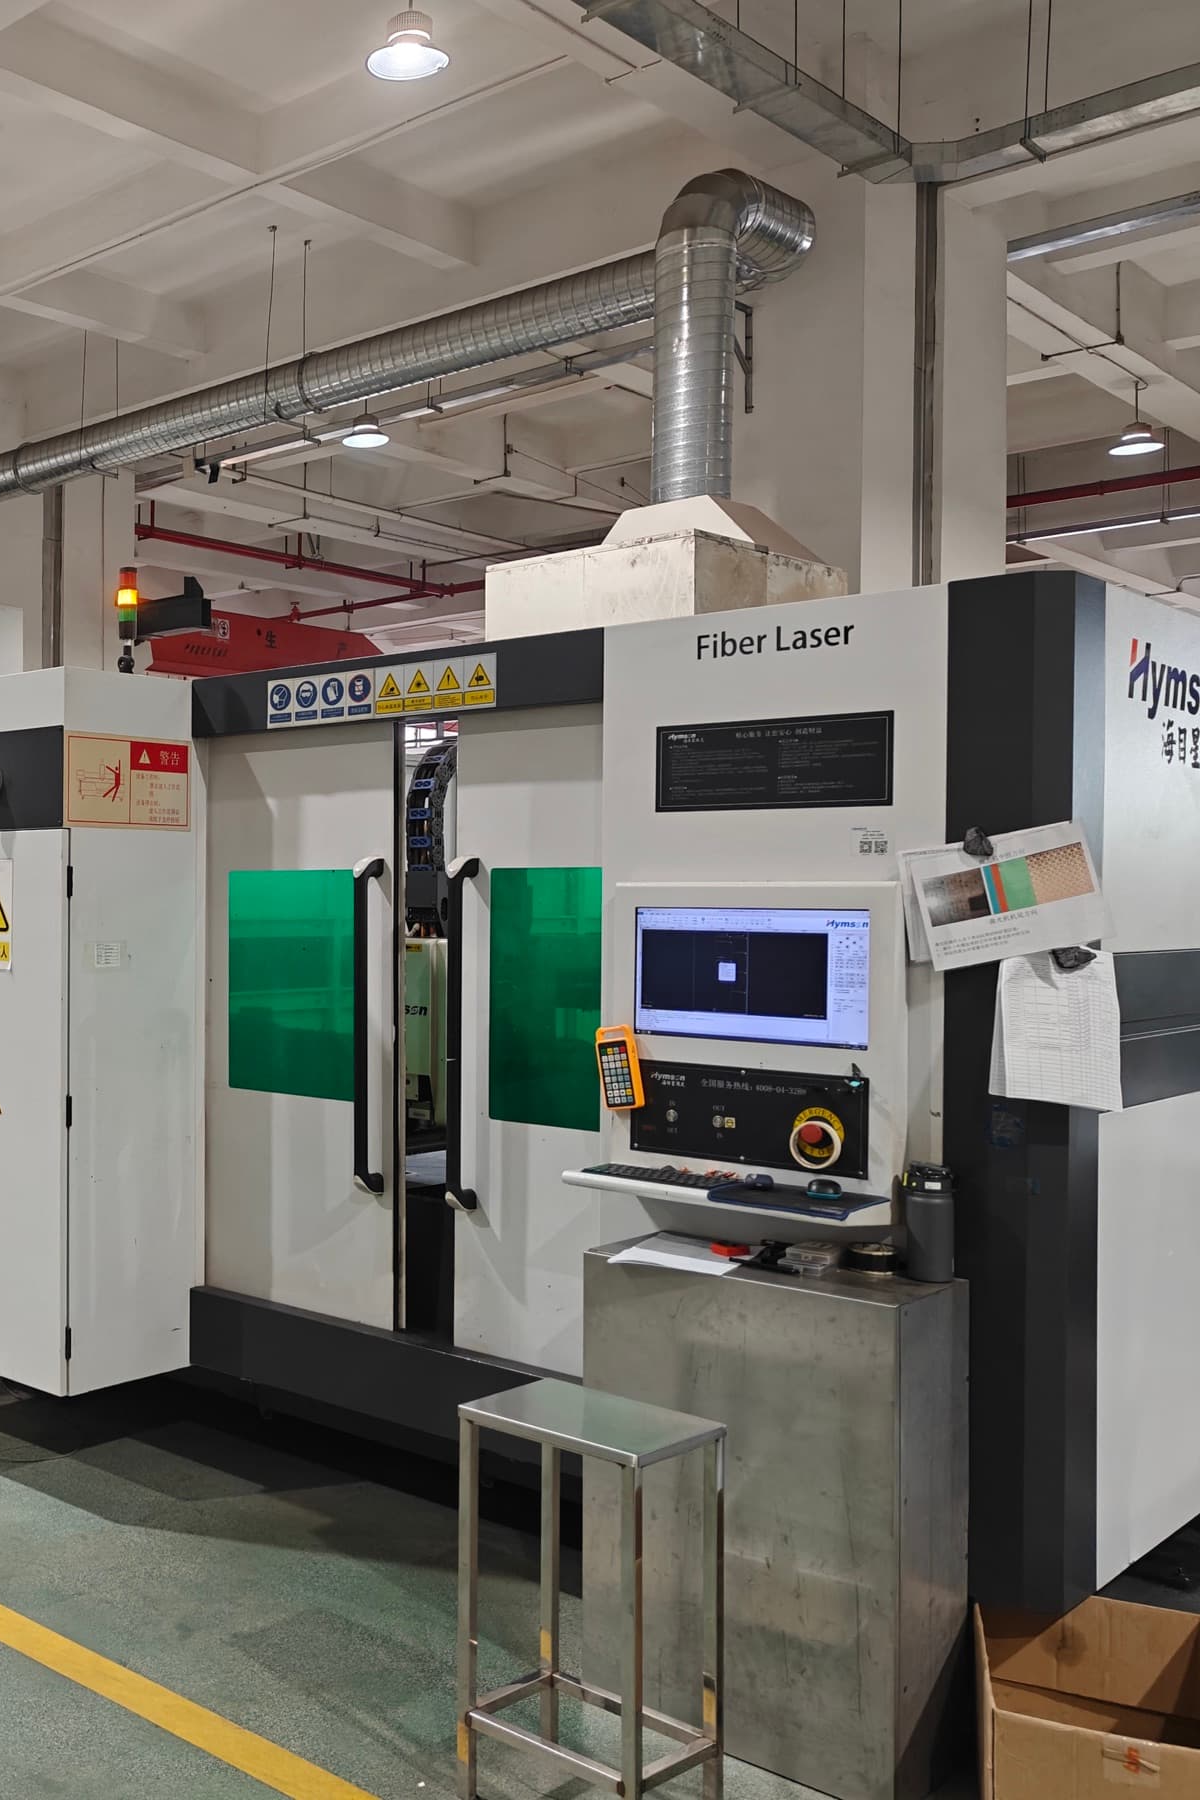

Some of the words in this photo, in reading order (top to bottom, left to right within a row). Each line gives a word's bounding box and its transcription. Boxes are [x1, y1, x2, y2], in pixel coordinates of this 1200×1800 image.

[697, 631, 767, 660] Fiber
[776, 624, 855, 652] Laser
[1127, 637, 1200, 720] Hyms
[160, 750, 180, 767] 警告
[795, 1109, 842, 1132] MERGENCY
